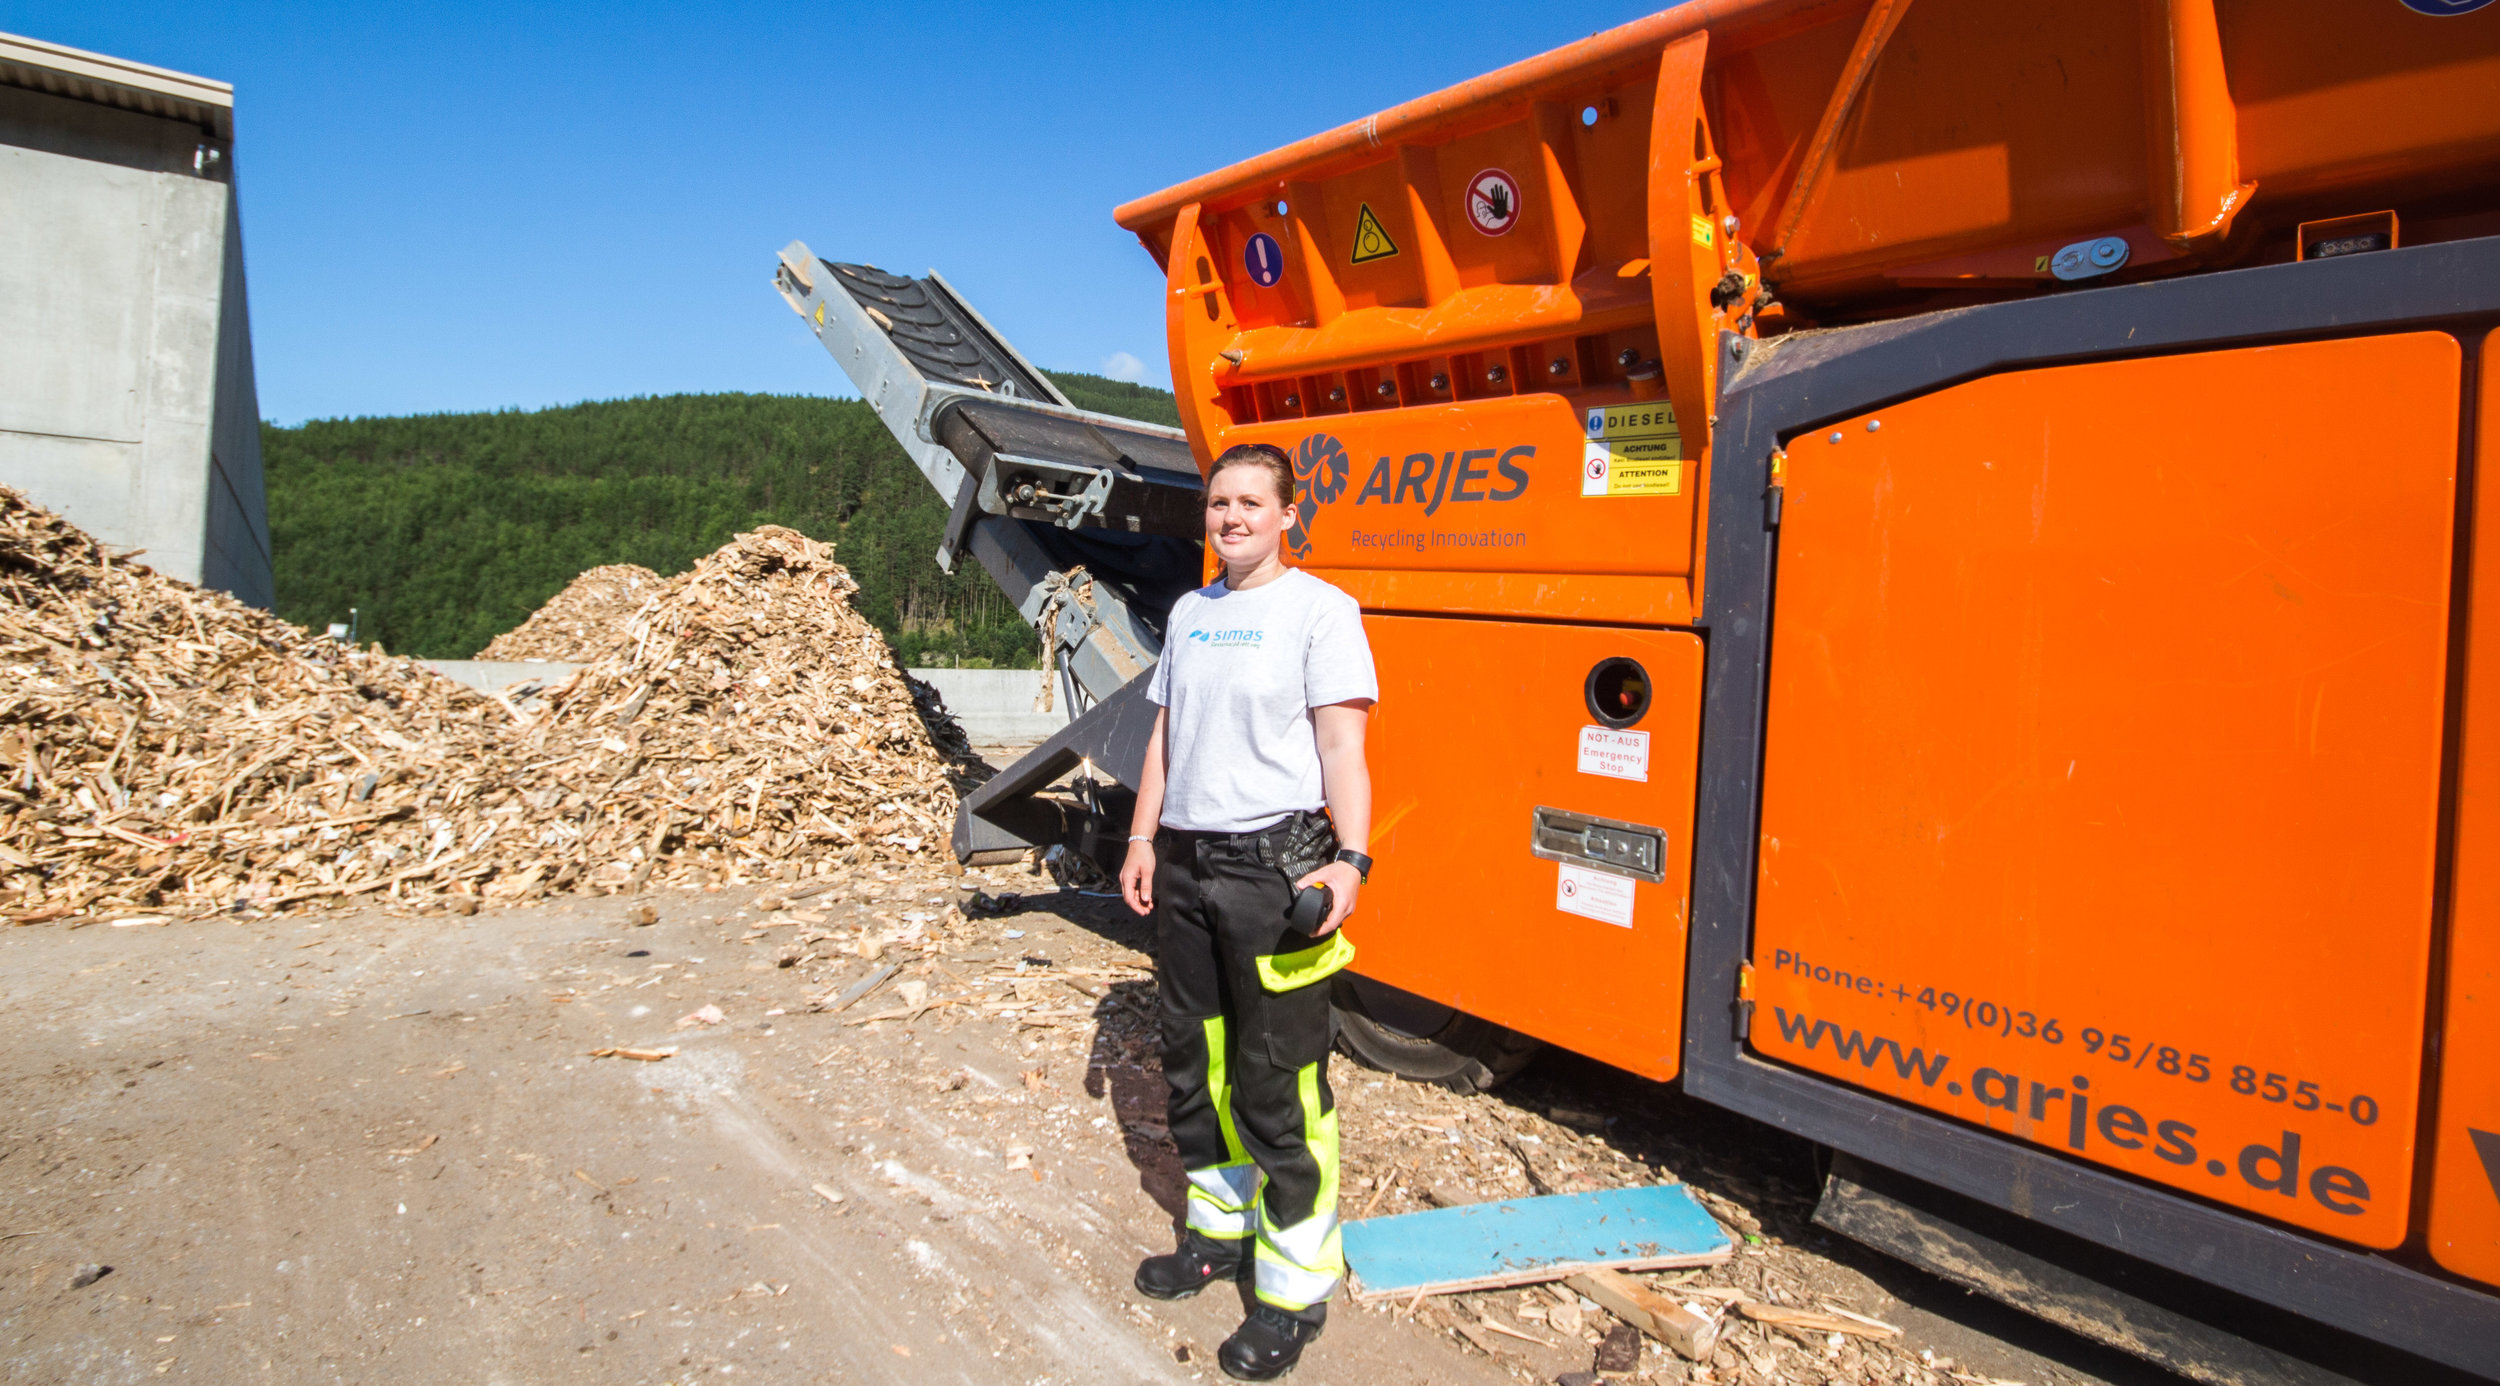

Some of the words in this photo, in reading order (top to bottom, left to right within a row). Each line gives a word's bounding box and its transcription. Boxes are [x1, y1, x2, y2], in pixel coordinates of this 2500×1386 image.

[1608, 411, 1677, 429] DIESEL
[1623, 443, 1667, 454] ACHTUNG
[1355, 445, 1537, 518] ARJES
[1619, 469, 1669, 478] ATTENTION
[1352, 529, 1425, 552] Recycling
[1431, 528, 1526, 547] Innovation
[1583, 747, 1642, 766] Emergency
[1599, 760, 1624, 773] Stop
[2081, 1027, 2211, 1083] 95/85
[2229, 1065, 2379, 1127] 855-0
[1773, 1006, 2371, 1216] www.arjes.de
